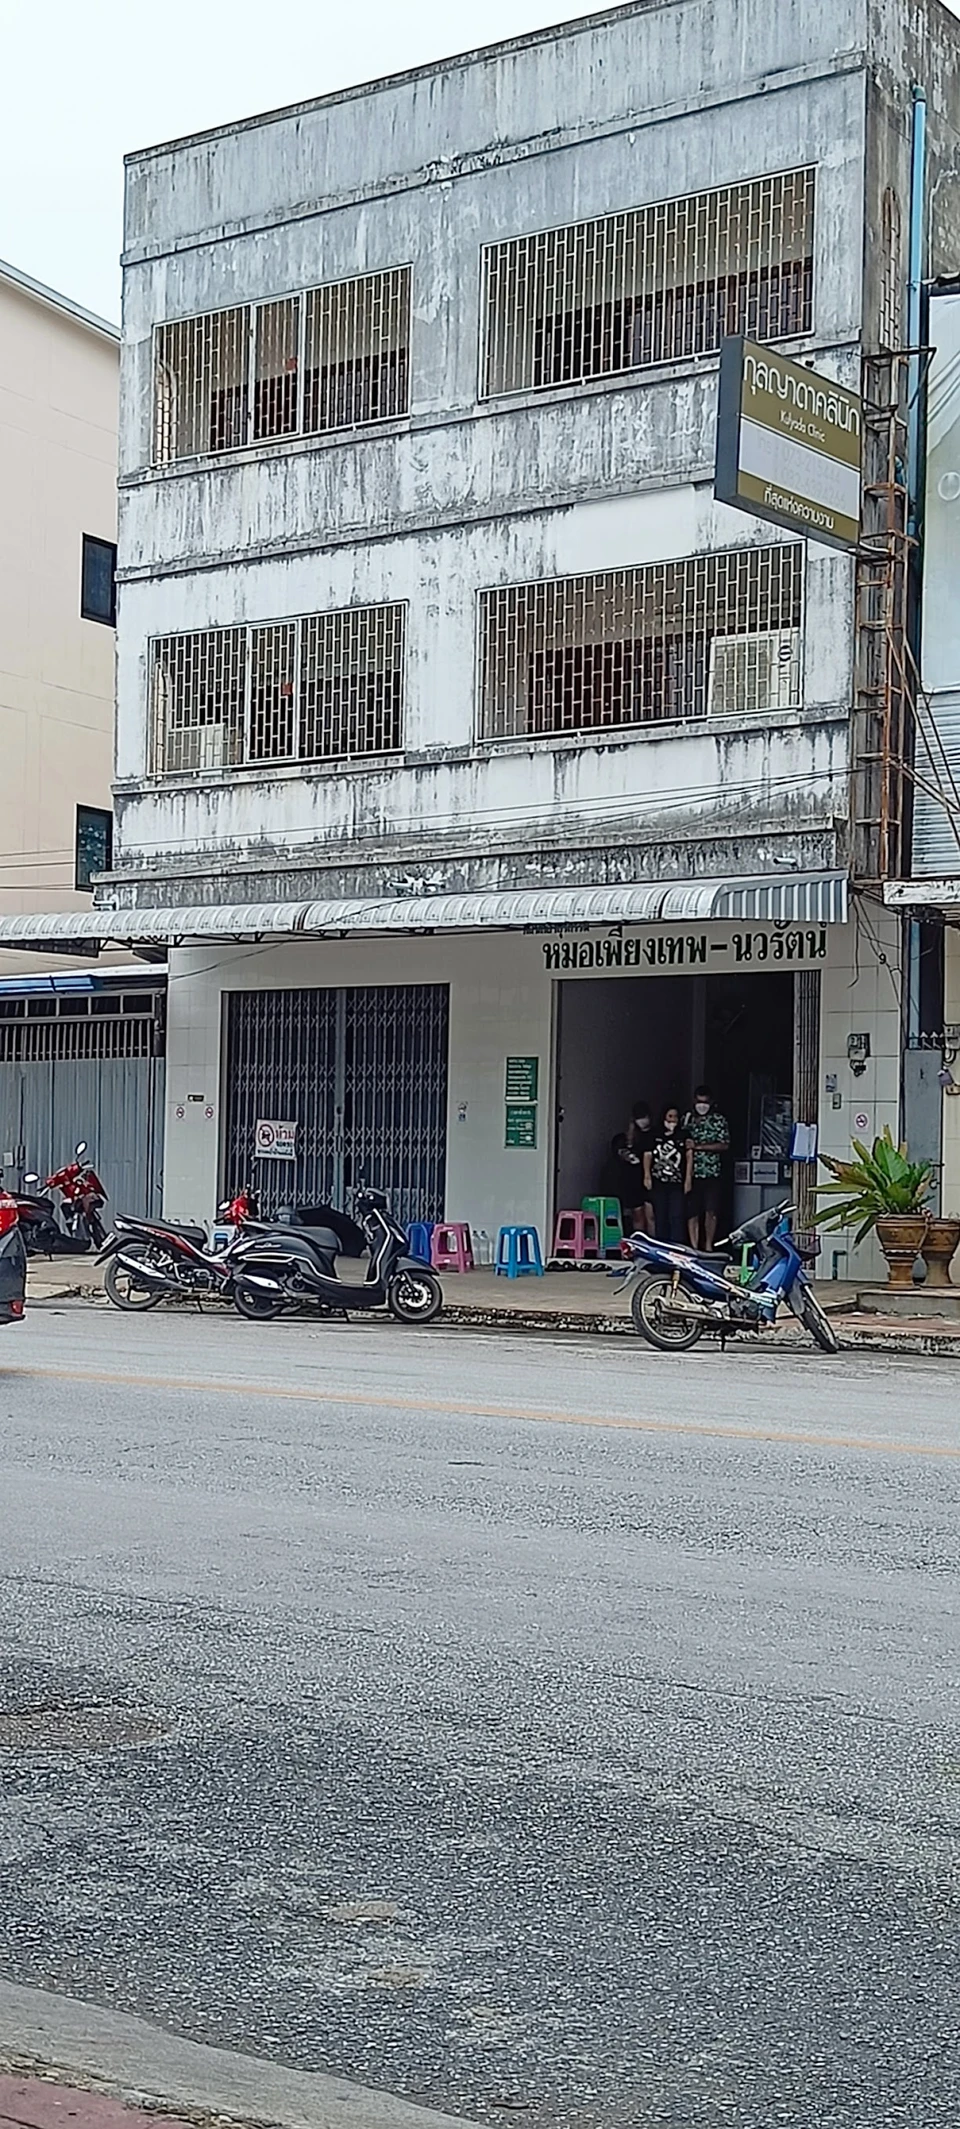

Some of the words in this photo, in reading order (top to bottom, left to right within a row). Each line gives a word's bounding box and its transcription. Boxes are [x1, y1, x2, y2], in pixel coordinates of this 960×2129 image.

[743, 355, 860, 436] กุลญาดาคลินิก
[780, 409, 807, 433] Kulyada
[807, 423, 826, 443] Clinic
[763, 485, 835, 530] ที่สุดแห่งความงาม
